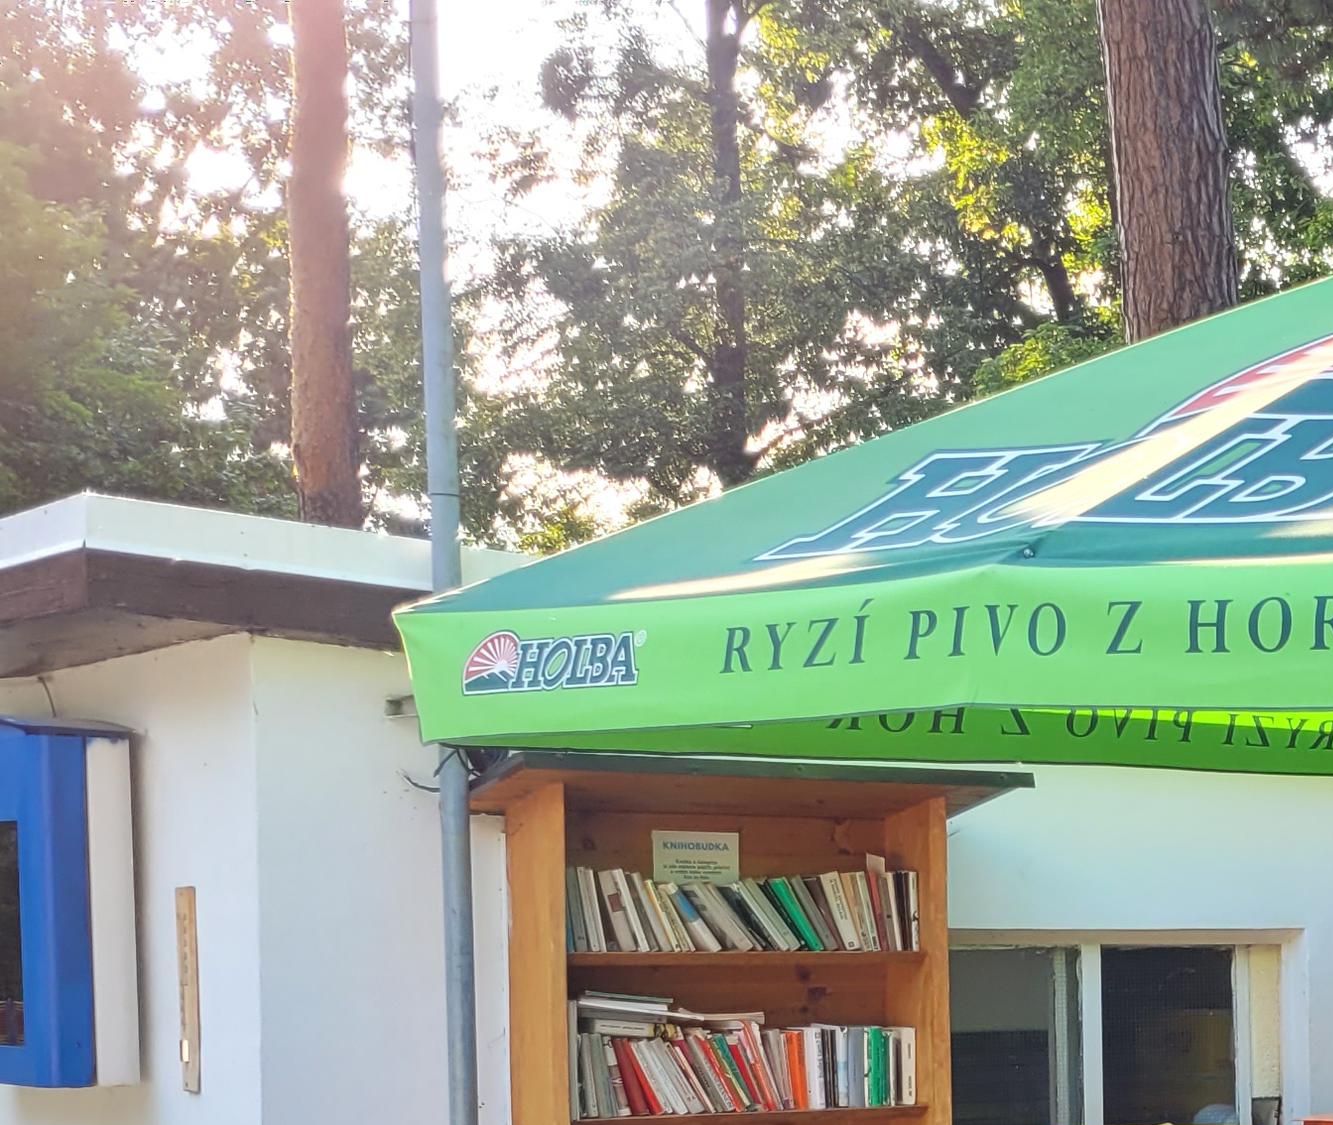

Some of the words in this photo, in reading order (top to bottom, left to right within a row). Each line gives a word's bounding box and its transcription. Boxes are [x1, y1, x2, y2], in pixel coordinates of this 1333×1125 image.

[510, 631, 639, 690] HOLBA
[719, 597, 876, 675] RYZÍ
[904, 601, 1067, 661] PIVO
[1105, 600, 1143, 655] Z
[662, 841, 730, 851] KNIHOBUDKA
